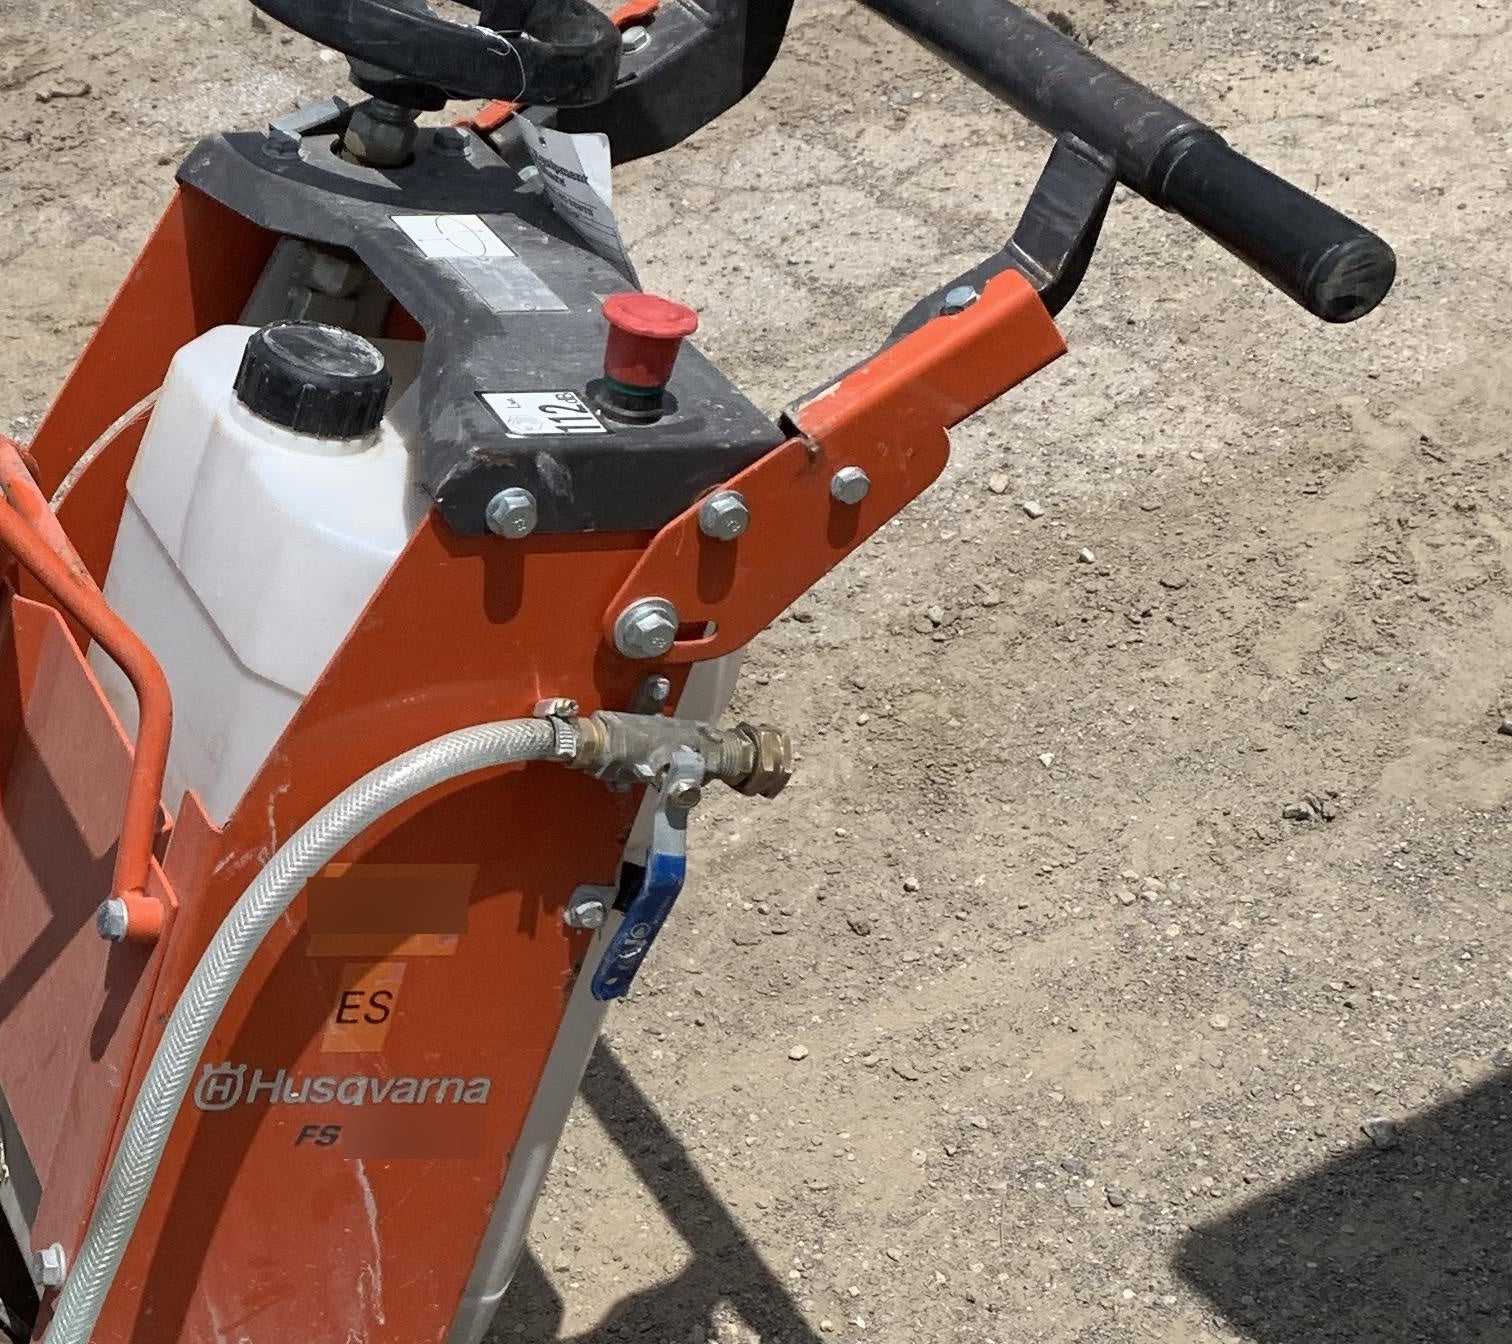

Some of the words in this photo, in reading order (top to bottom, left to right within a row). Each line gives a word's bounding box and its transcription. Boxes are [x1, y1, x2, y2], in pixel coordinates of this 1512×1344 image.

[538, 404, 601, 433] 112
[335, 989, 394, 1025] ES
[245, 1067, 494, 1106] Husqvarna
[294, 1124, 343, 1148] FS
